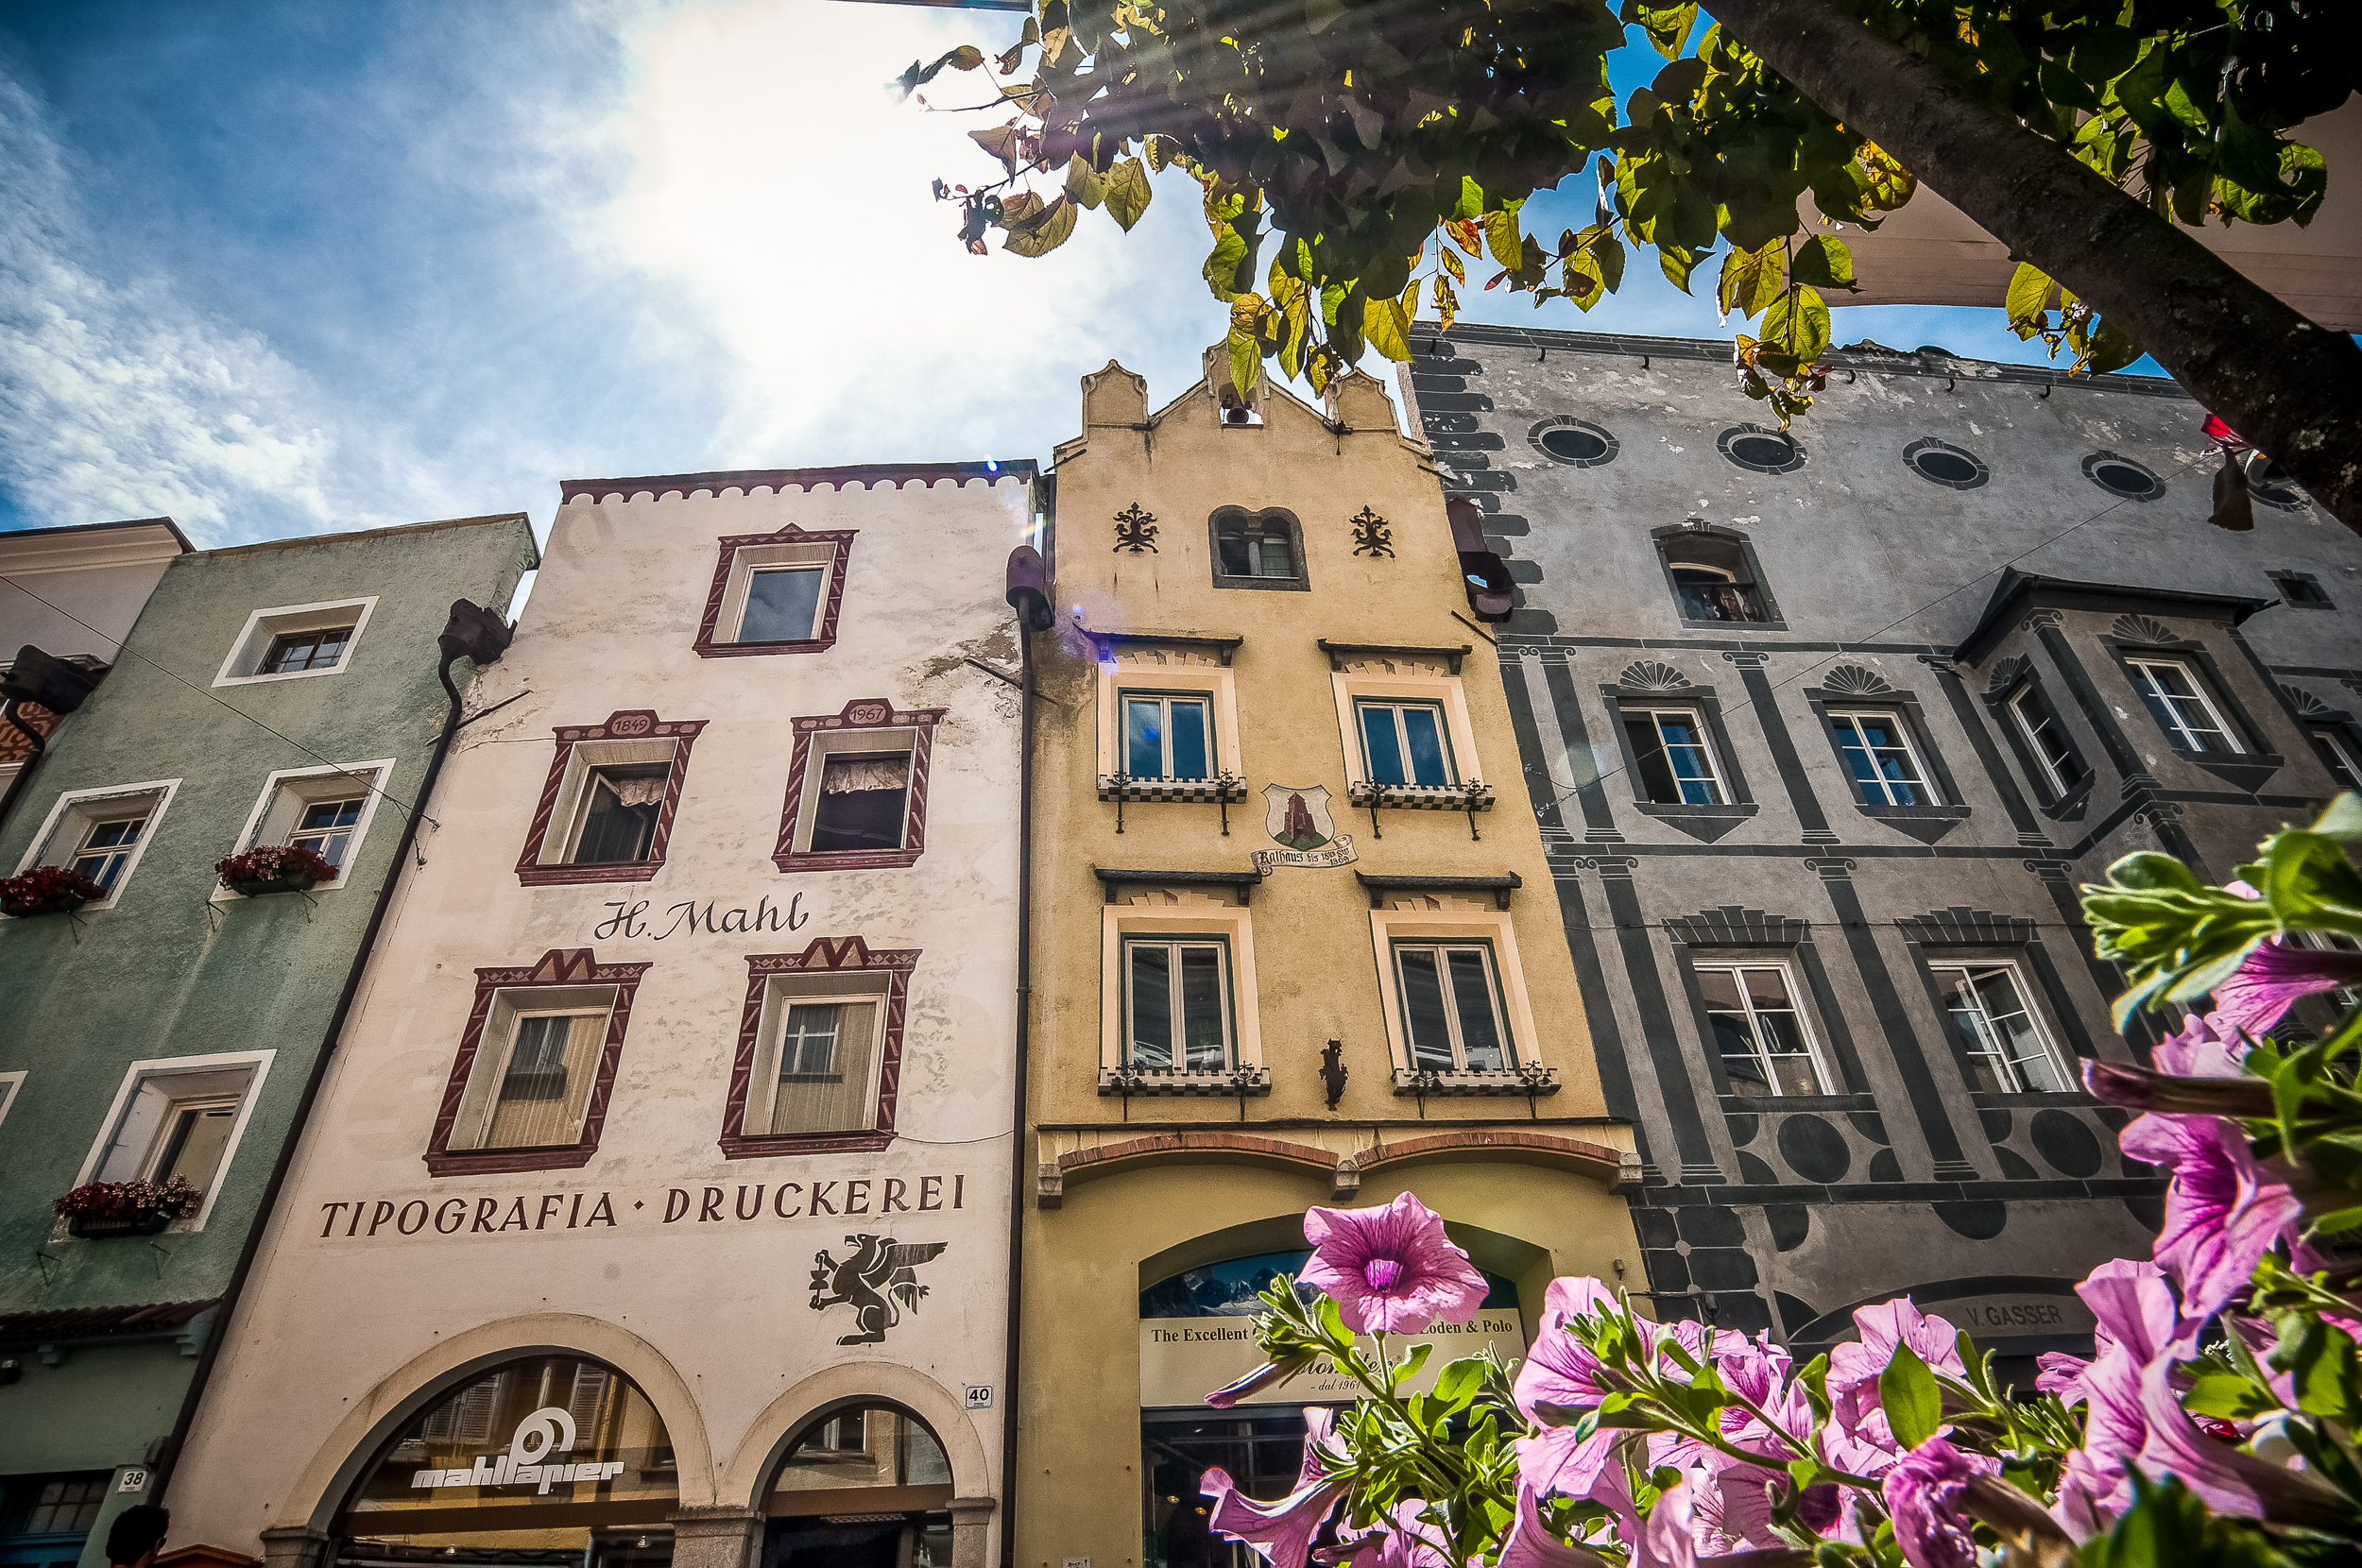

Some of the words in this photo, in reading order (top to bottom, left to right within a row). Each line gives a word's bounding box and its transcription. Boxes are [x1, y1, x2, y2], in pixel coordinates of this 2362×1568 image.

[850, 707, 884, 720] 1967
[614, 719, 648, 732] 1849
[1258, 850, 1304, 864] Rathaus
[1307, 852, 1319, 862] bis
[1329, 856, 1350, 866] 1809
[593, 899, 652, 940] H.
[653, 891, 810, 941] Mahl
[319, 1191, 618, 1238] TIPOGRAFIA
[661, 1174, 965, 1223] DRUCKEREI
[1965, 1307, 1984, 1326] V.
[1985, 1304, 2063, 1326] GASSER
[1152, 1329, 1179, 1342] The
[1183, 1327, 1248, 1341] Excellent
[1465, 1321, 1479, 1333] &
[1482, 1320, 1513, 1333] Polo
[1318, 1378, 1337, 1391] dal
[1337, 1379, 1361, 1390] 1961
[968, 1388, 989, 1401] 40
[124, 1472, 145, 1486] 38
